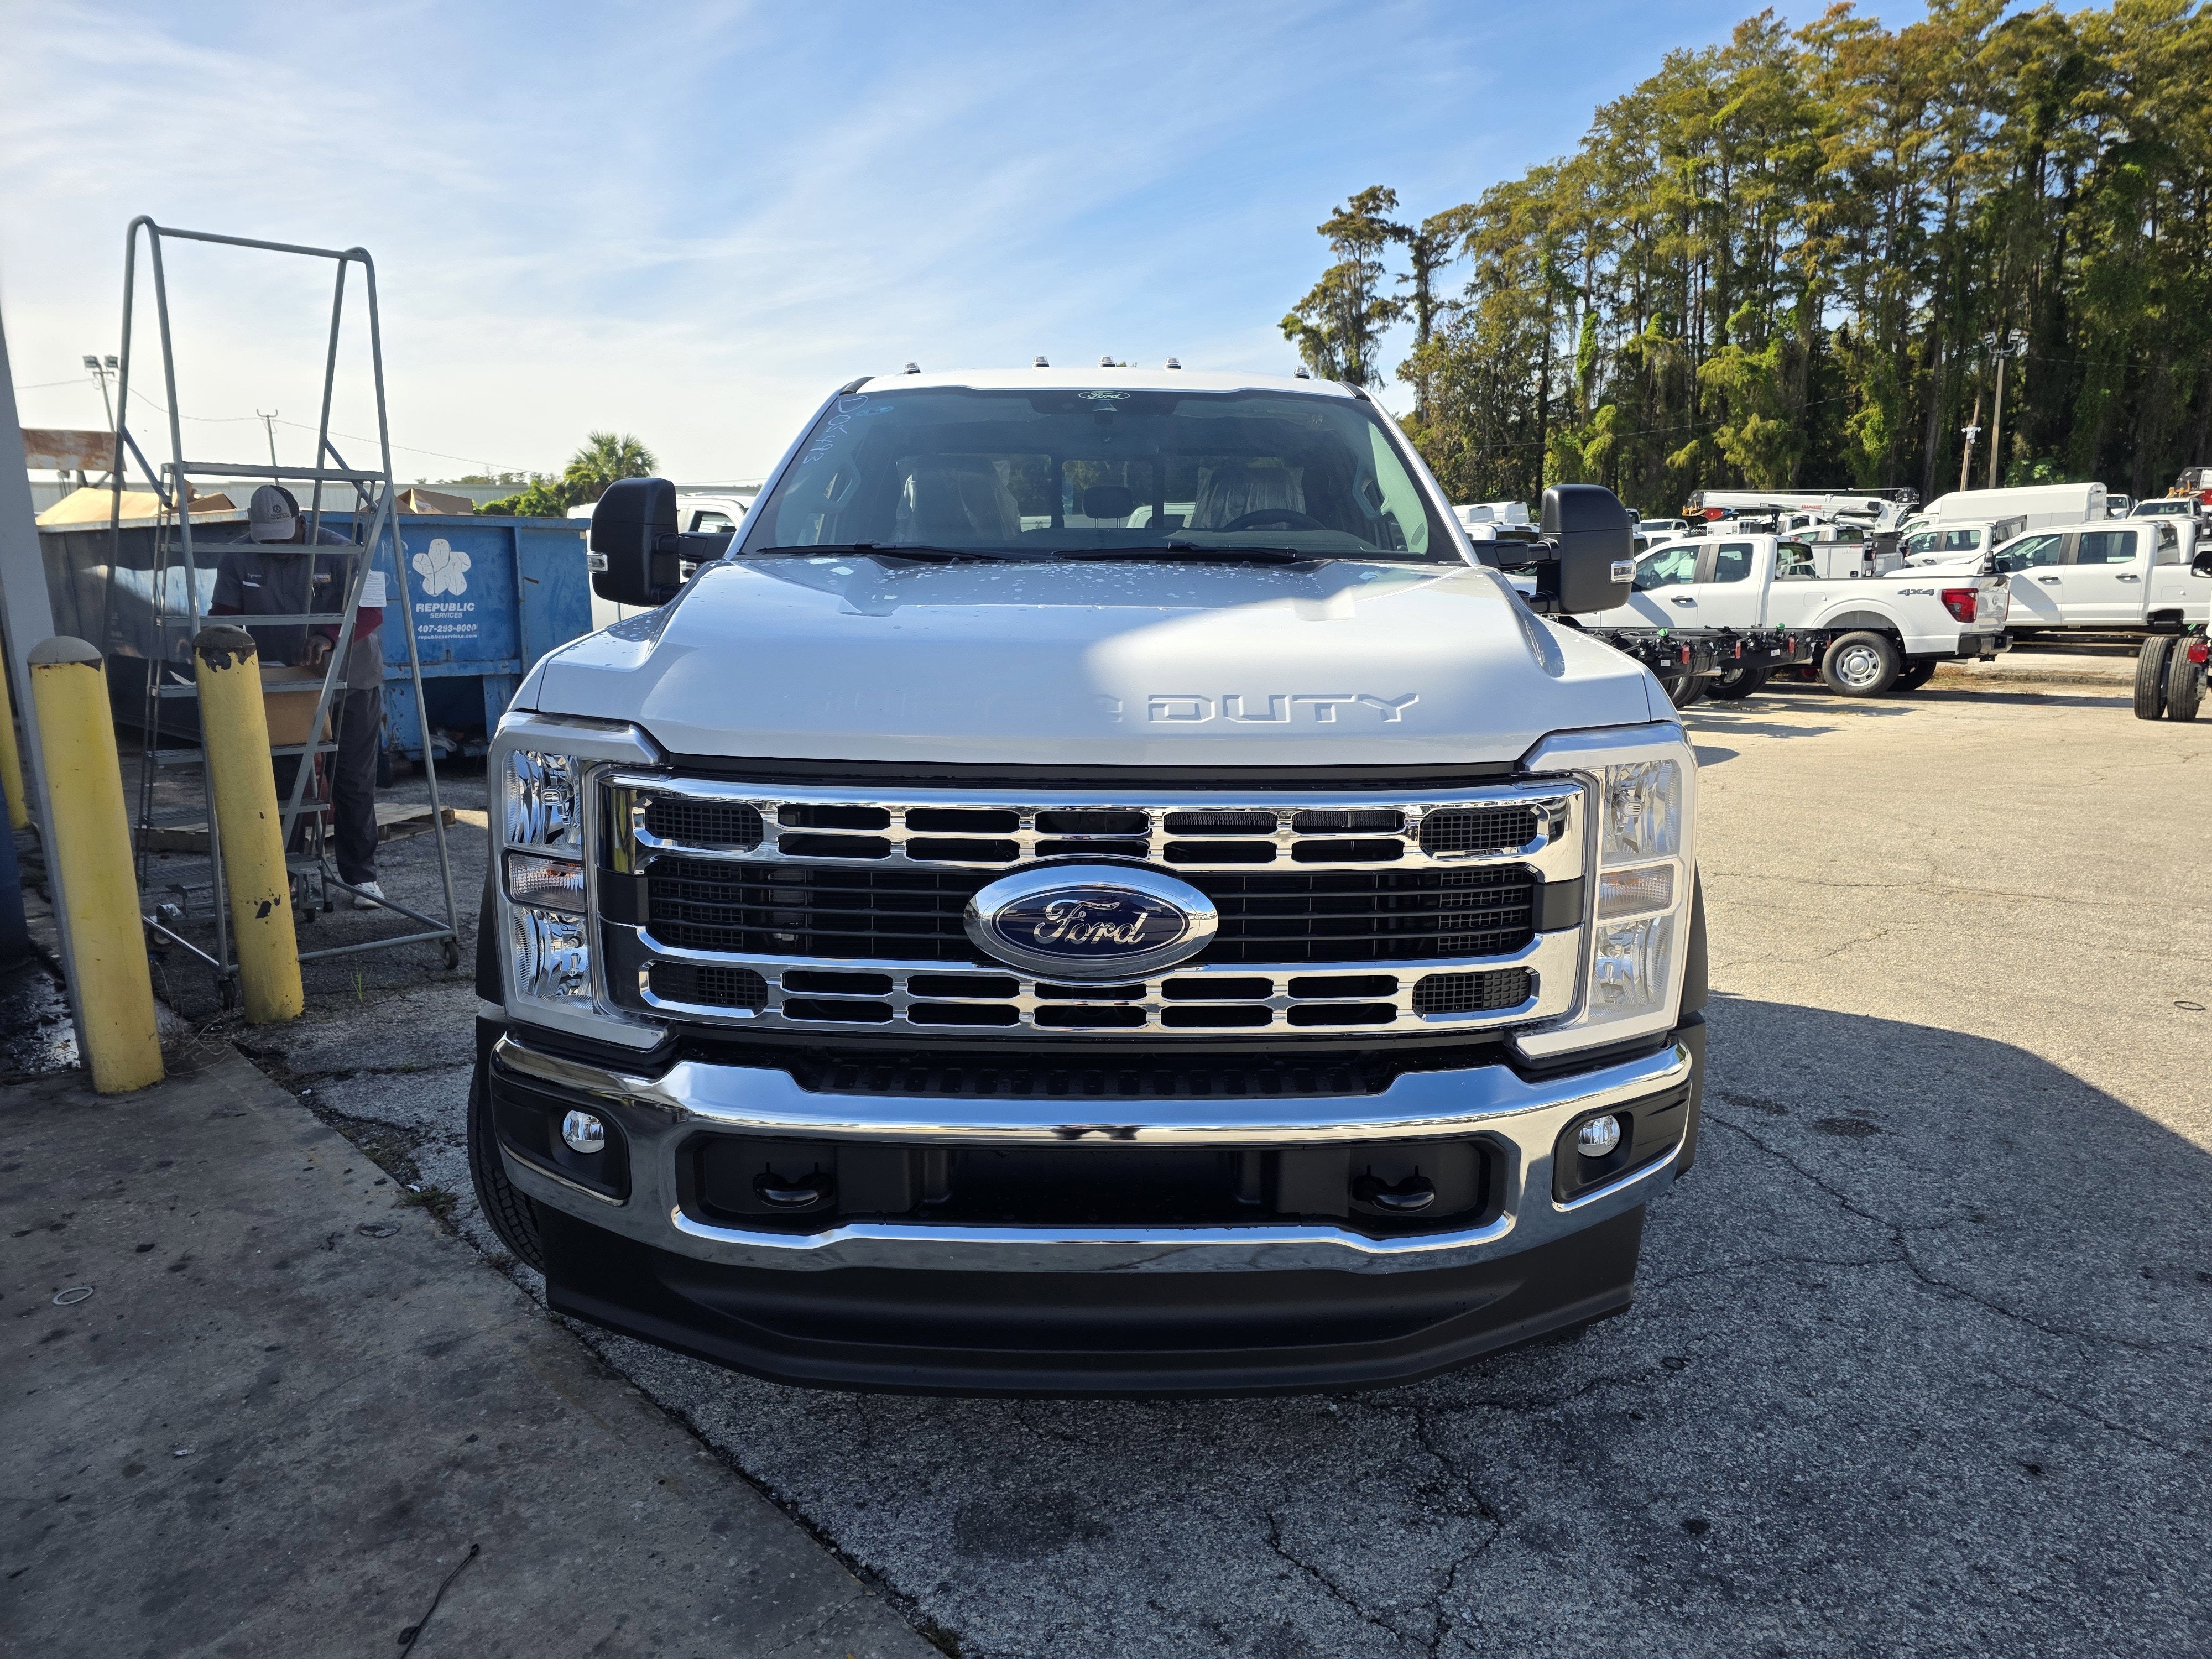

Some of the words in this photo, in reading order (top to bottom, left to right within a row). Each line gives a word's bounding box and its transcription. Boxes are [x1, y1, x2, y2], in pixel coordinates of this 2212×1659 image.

[415, 603, 476, 612] REPUBLIC
[417, 624, 477, 633] 407-293-8000
[1147, 694, 1419, 723] DUTY
[1034, 899, 1149, 945] Ford
